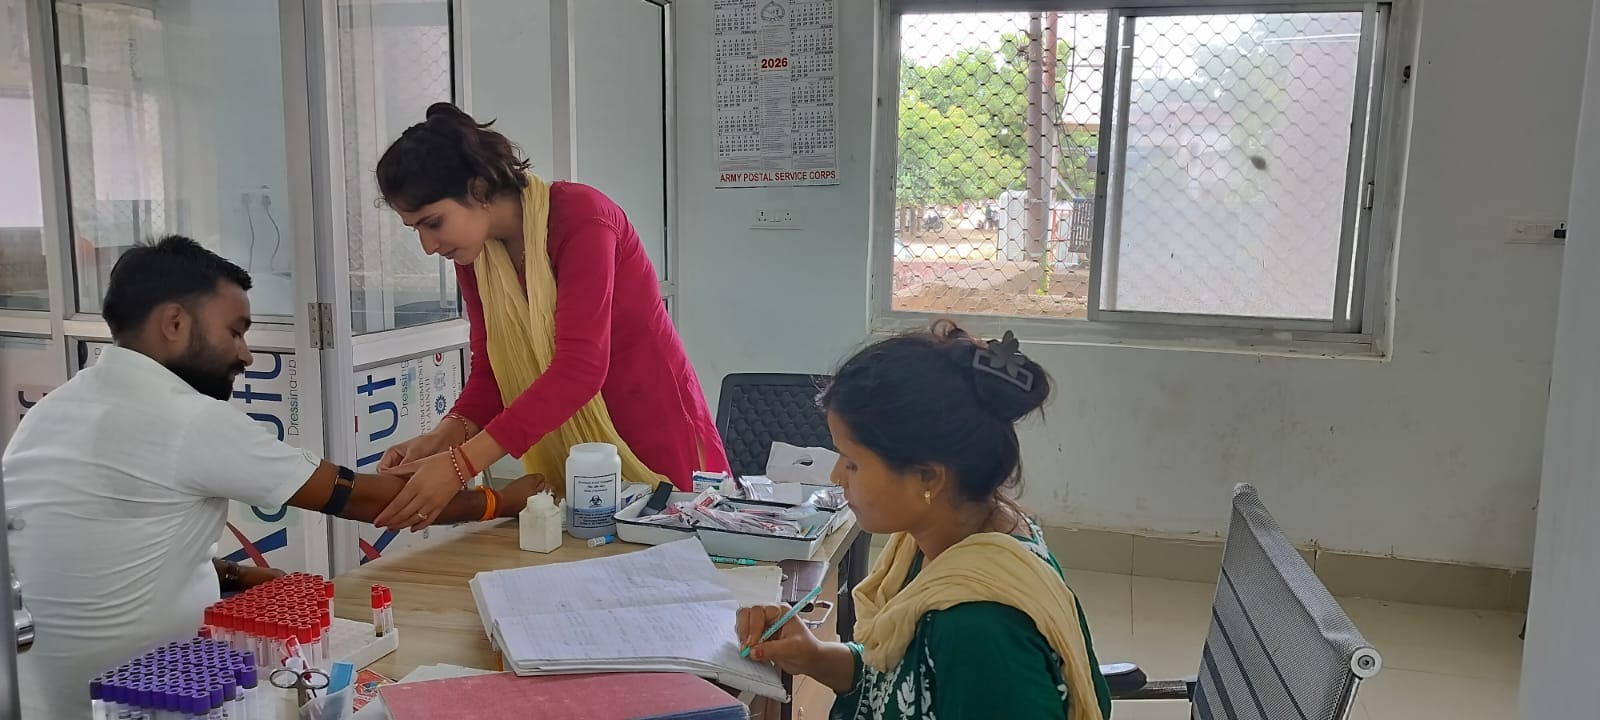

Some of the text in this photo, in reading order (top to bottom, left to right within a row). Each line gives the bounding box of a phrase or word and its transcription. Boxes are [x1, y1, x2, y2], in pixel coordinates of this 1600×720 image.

[761, 57, 788, 69] 2026
[720, 170, 836, 183] ARMY POSTAL SERVICE CORPS
